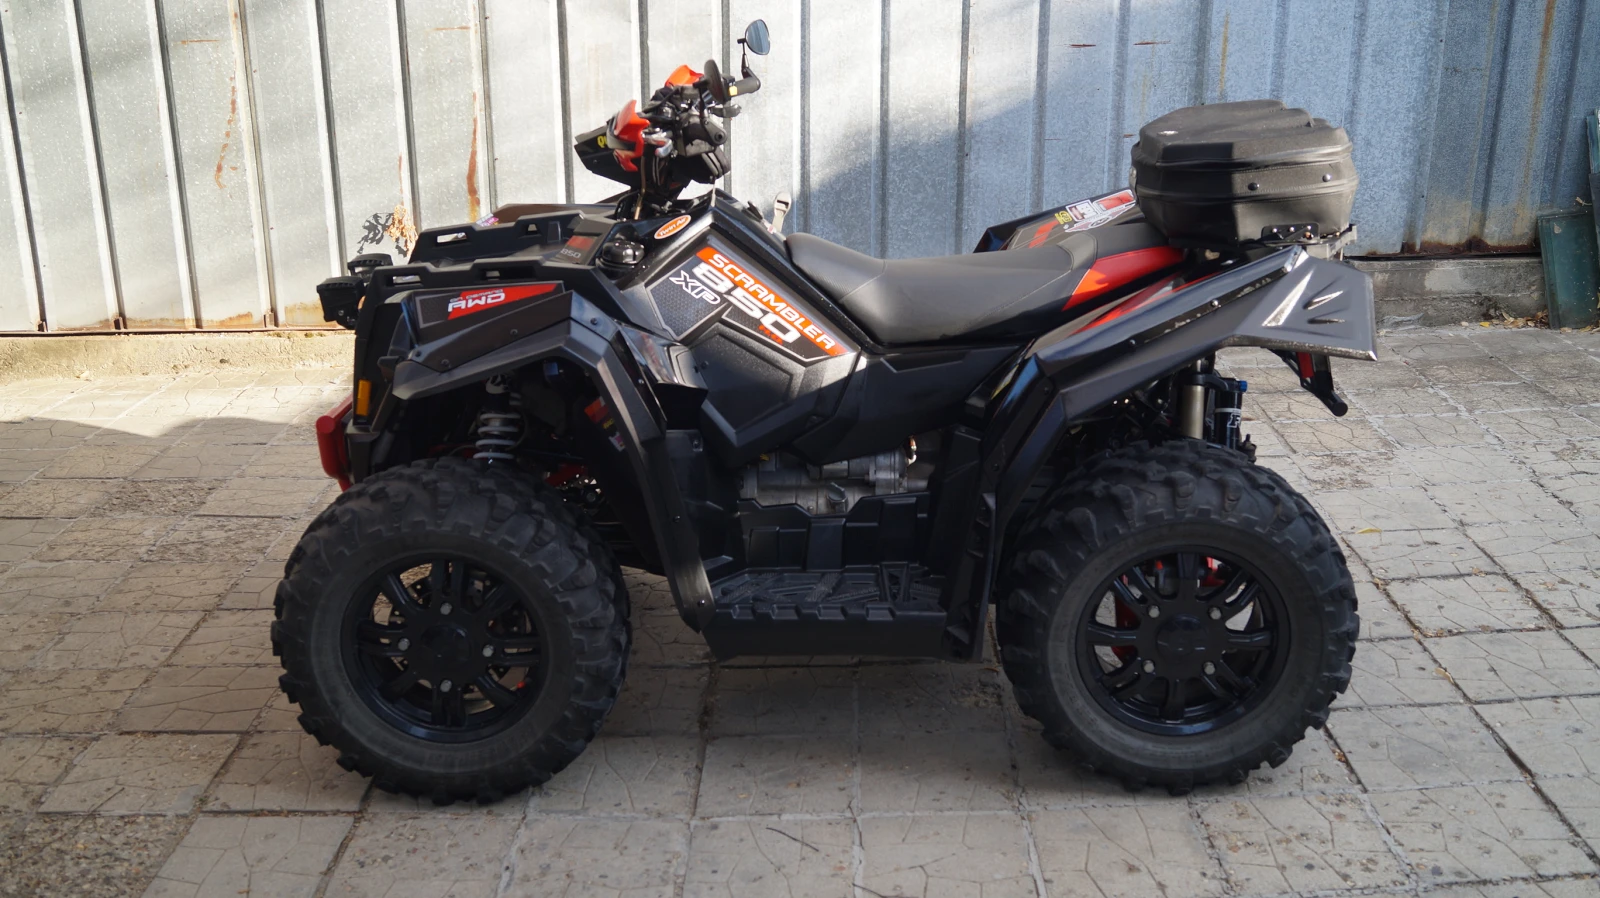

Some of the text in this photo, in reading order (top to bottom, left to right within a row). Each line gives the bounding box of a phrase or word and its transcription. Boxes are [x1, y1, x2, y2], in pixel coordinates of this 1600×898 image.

[659, 217, 687, 237] Twin Air
[560, 248, 581, 259] 850
[669, 270, 721, 305] XP
[709, 253, 836, 349] SCRAMBLER
[448, 293, 505, 312] AWD
[692, 262, 802, 343] 850
